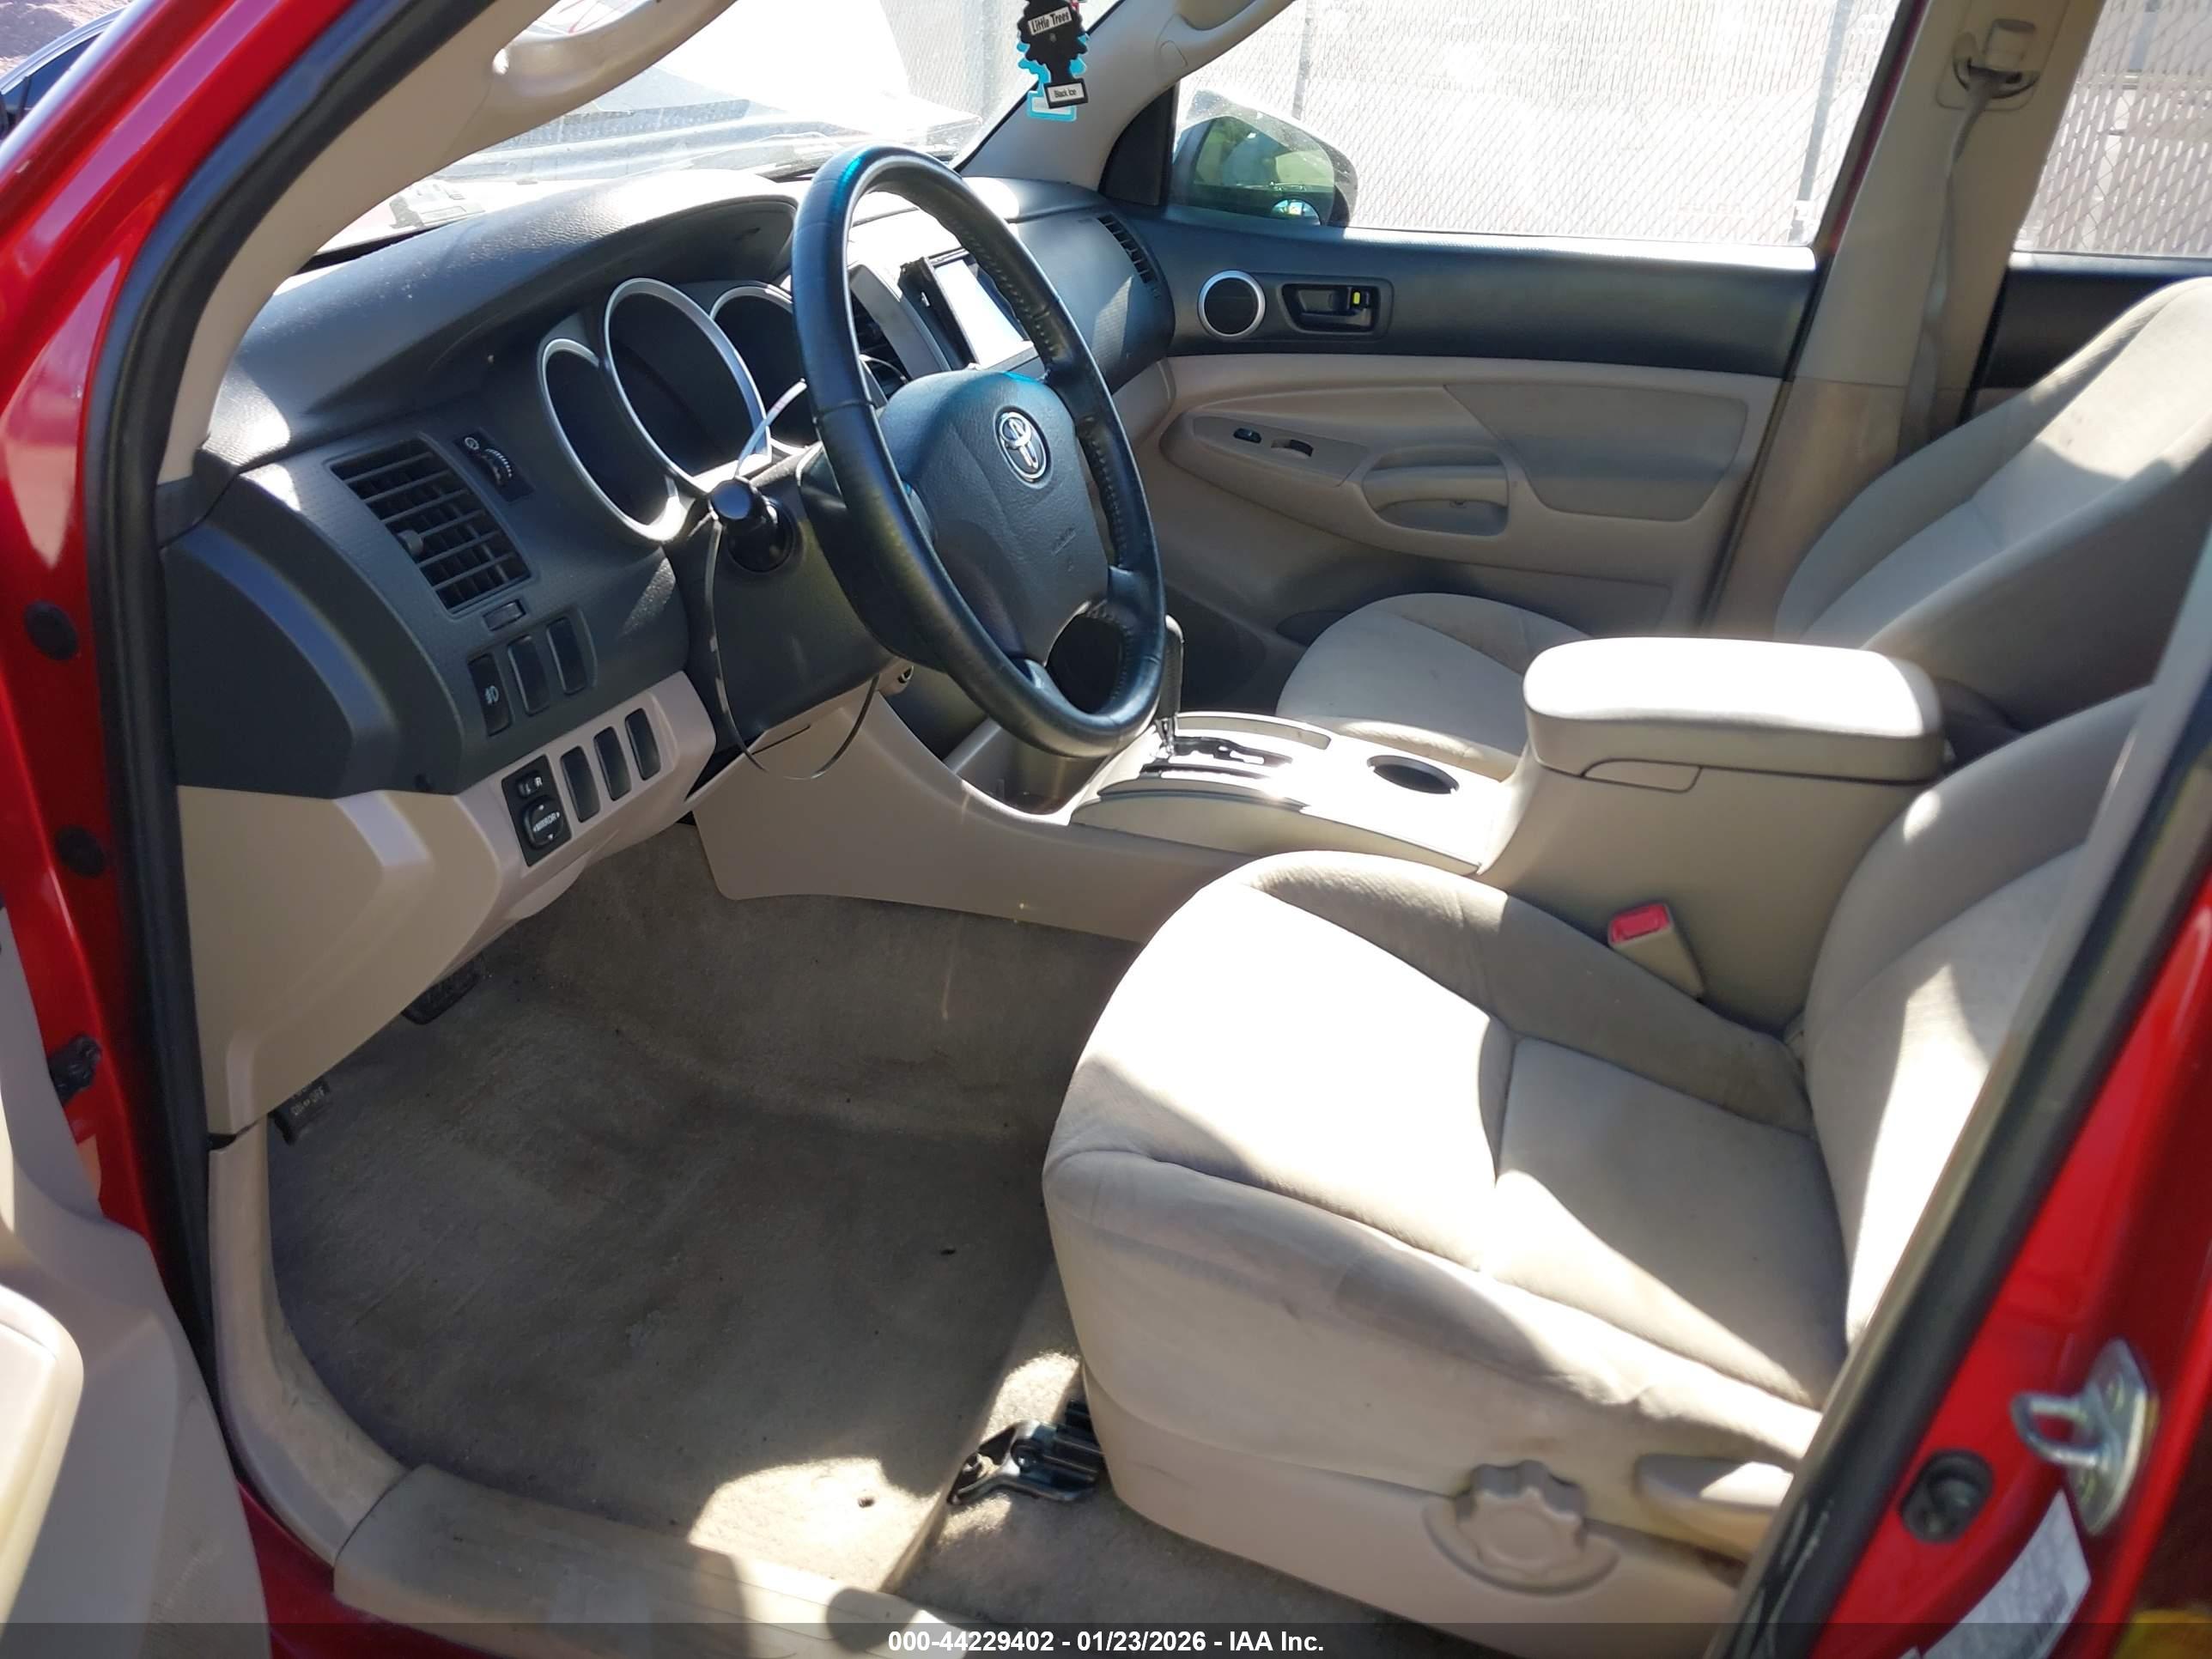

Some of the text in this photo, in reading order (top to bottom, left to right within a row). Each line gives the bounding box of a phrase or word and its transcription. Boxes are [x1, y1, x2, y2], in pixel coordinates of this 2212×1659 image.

[1031, 11, 1070, 33] Little Trees
[534, 776, 543, 787] R
